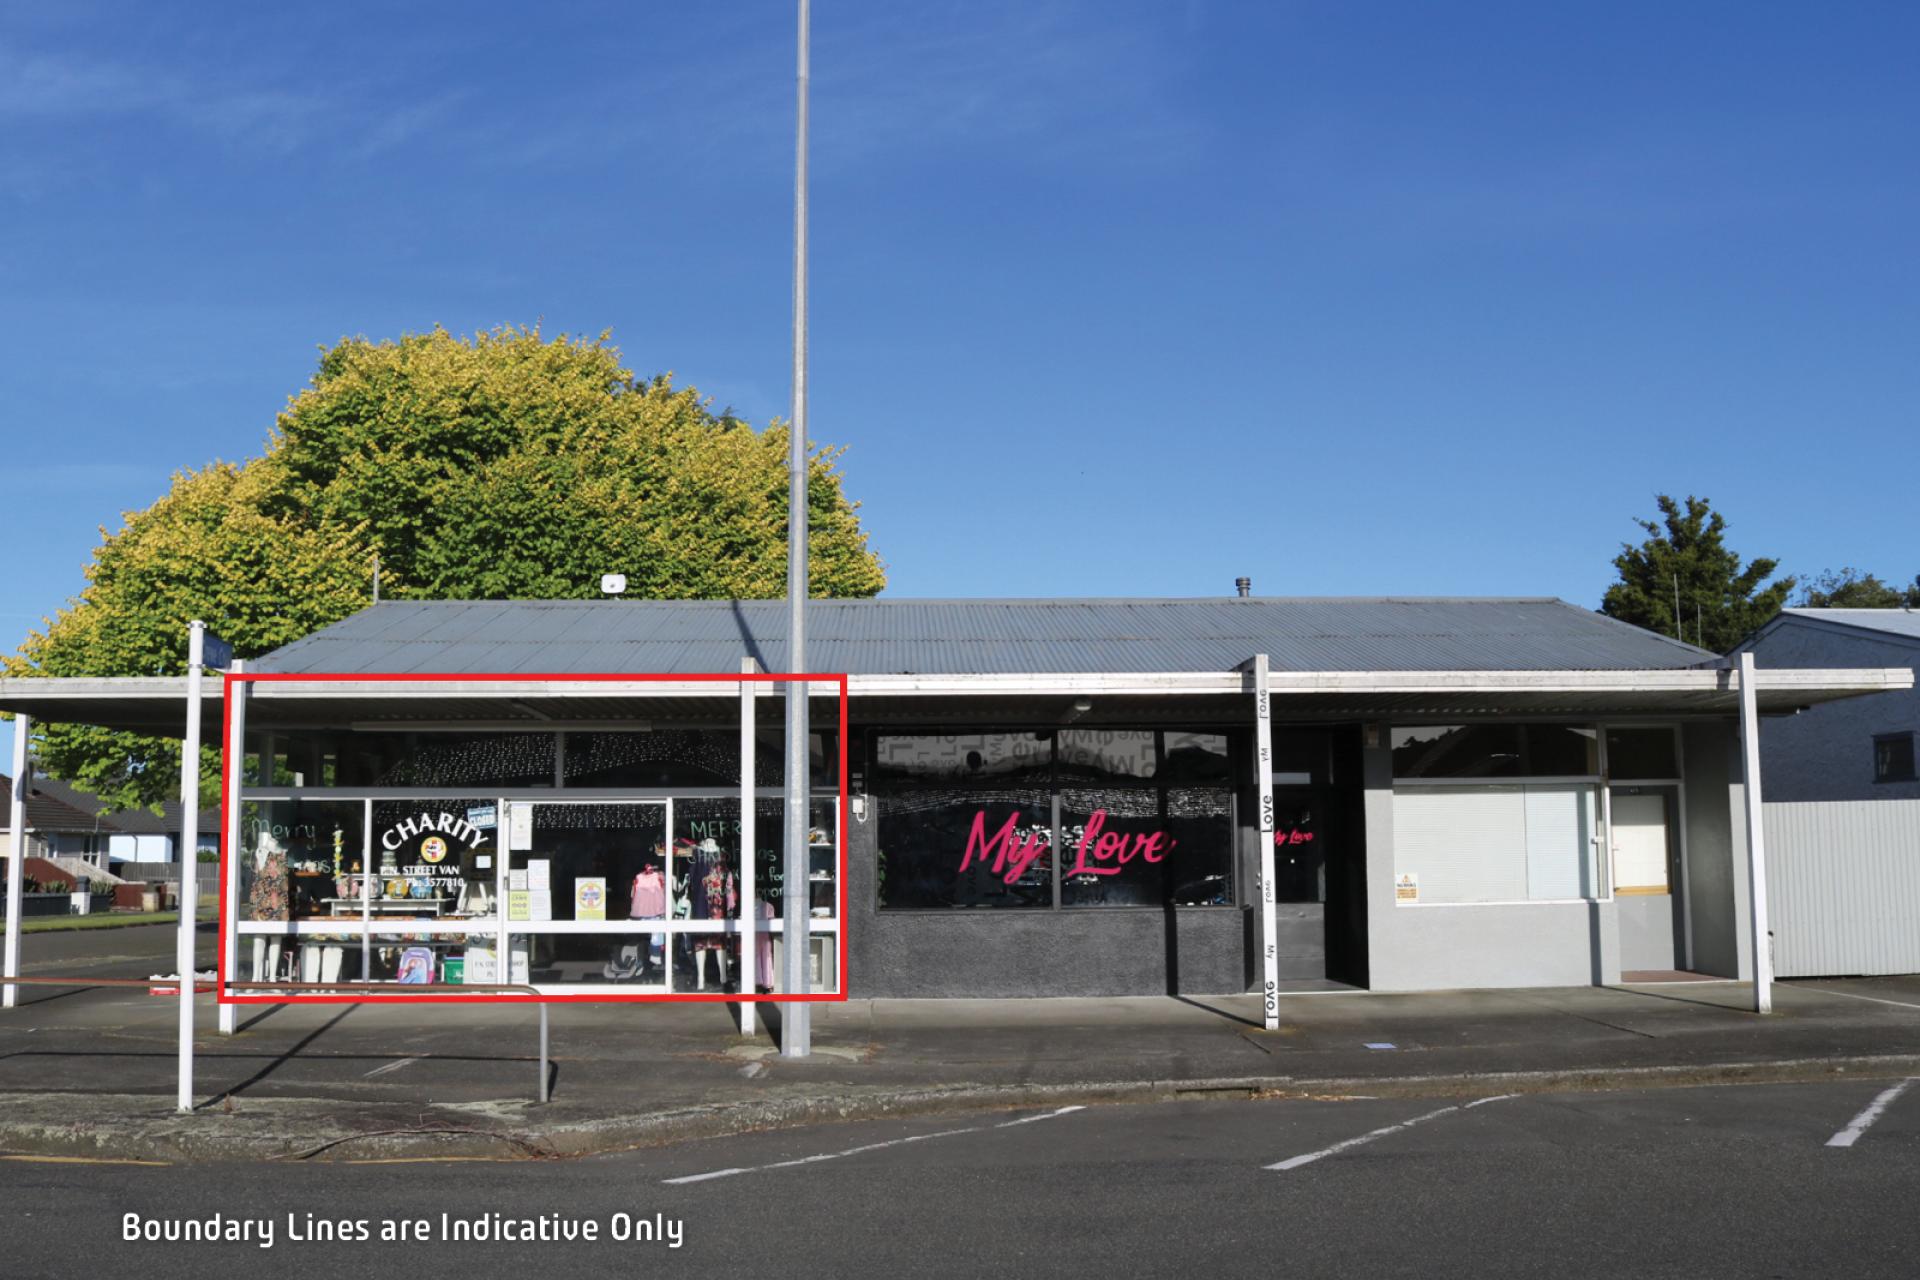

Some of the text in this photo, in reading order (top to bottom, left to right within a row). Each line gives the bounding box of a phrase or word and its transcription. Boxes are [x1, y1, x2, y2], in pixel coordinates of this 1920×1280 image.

[382, 811, 489, 850] CHARITY
[690, 820, 742, 839] MERR
[1261, 795, 1273, 833] Love
[959, 808, 1177, 884] My Love
[402, 865, 438, 877] STREET
[439, 865, 460, 876] VAN
